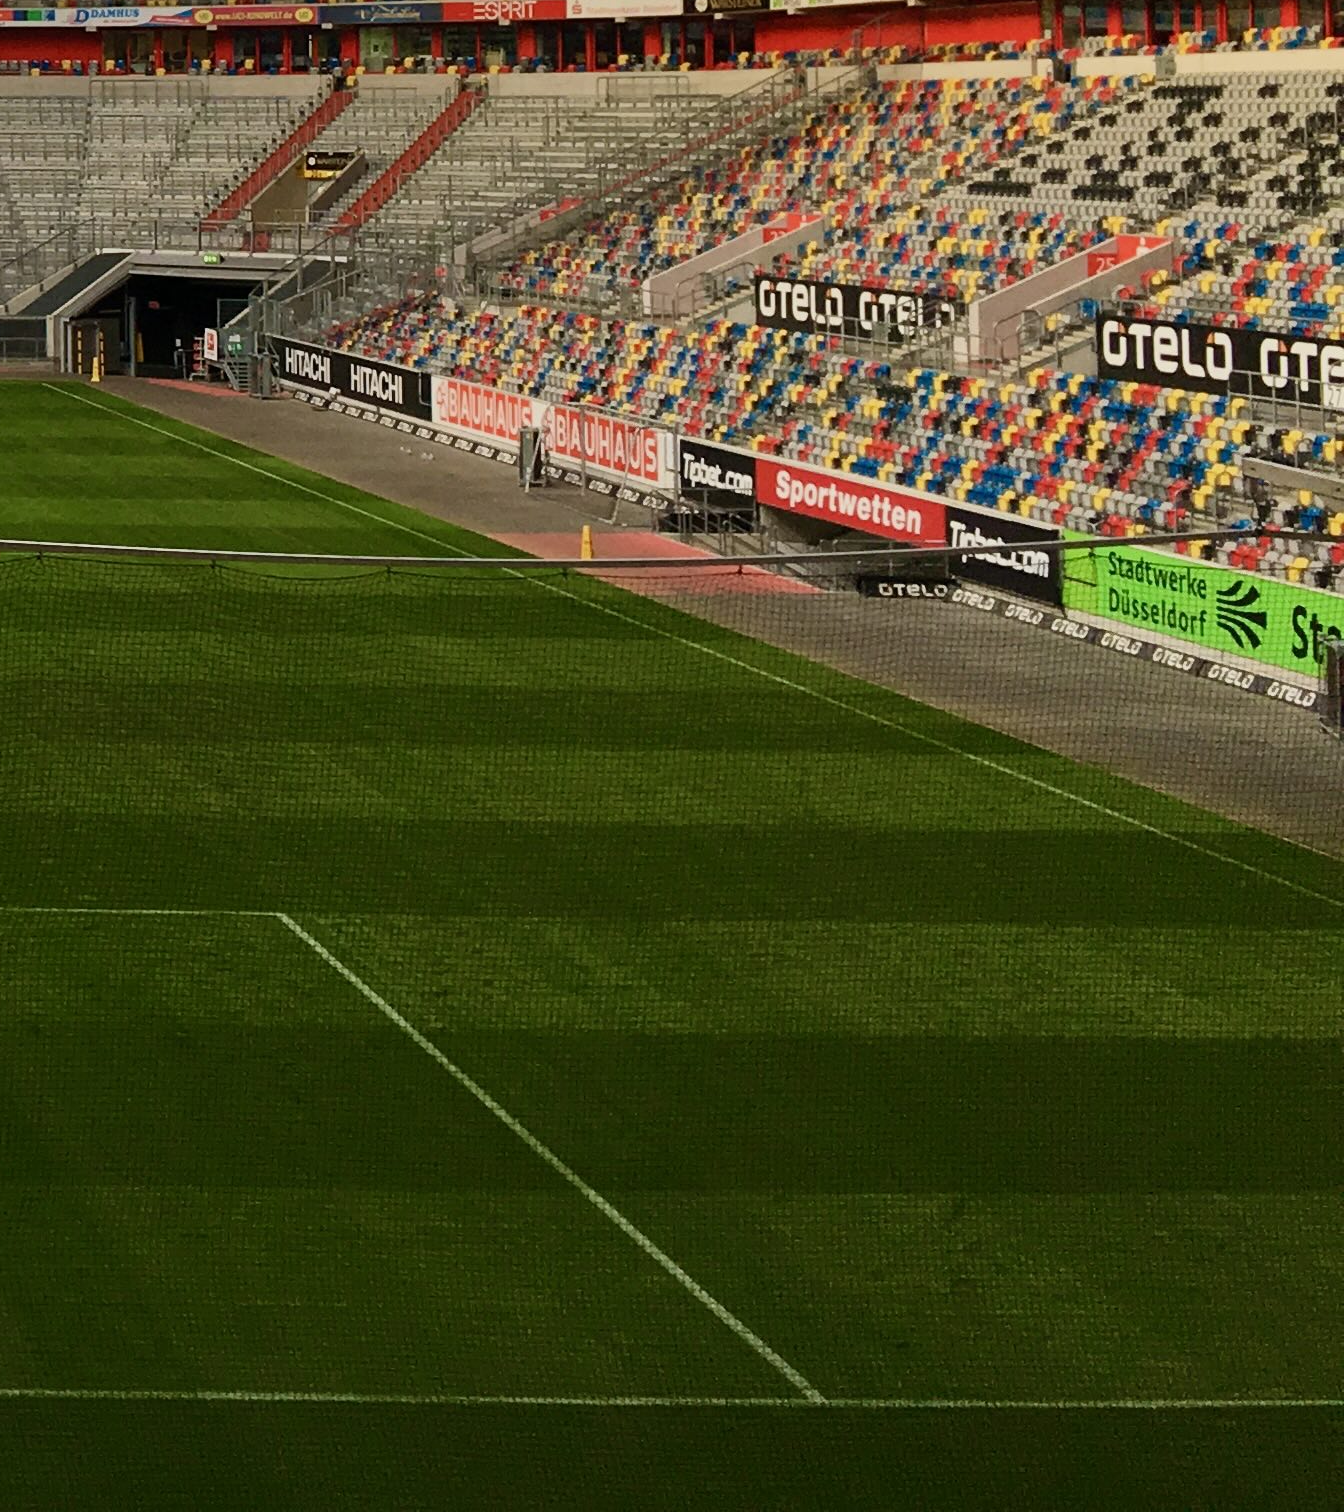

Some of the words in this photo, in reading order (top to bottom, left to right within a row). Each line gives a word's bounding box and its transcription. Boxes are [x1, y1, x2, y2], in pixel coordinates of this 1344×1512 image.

[91, 8, 140, 18] DAMHUS
[473, 1, 537, 20] ESPRIT
[759, 280, 844, 326] OTELO
[285, 348, 330, 384] HITACHI
[1102, 320, 1234, 381] OTELO
[350, 364, 403, 405] HITACHI
[448, 383, 532, 440] BAUHAUS
[555, 407, 657, 476] BAUHAUS
[683, 453, 753, 496] Tipbet.com
[776, 471, 921, 535] Sportwetten
[878, 582, 948, 598] OTELO
[1108, 551, 1207, 599] Stadtwerke
[1108, 588, 1207, 637] Düsseldorf
